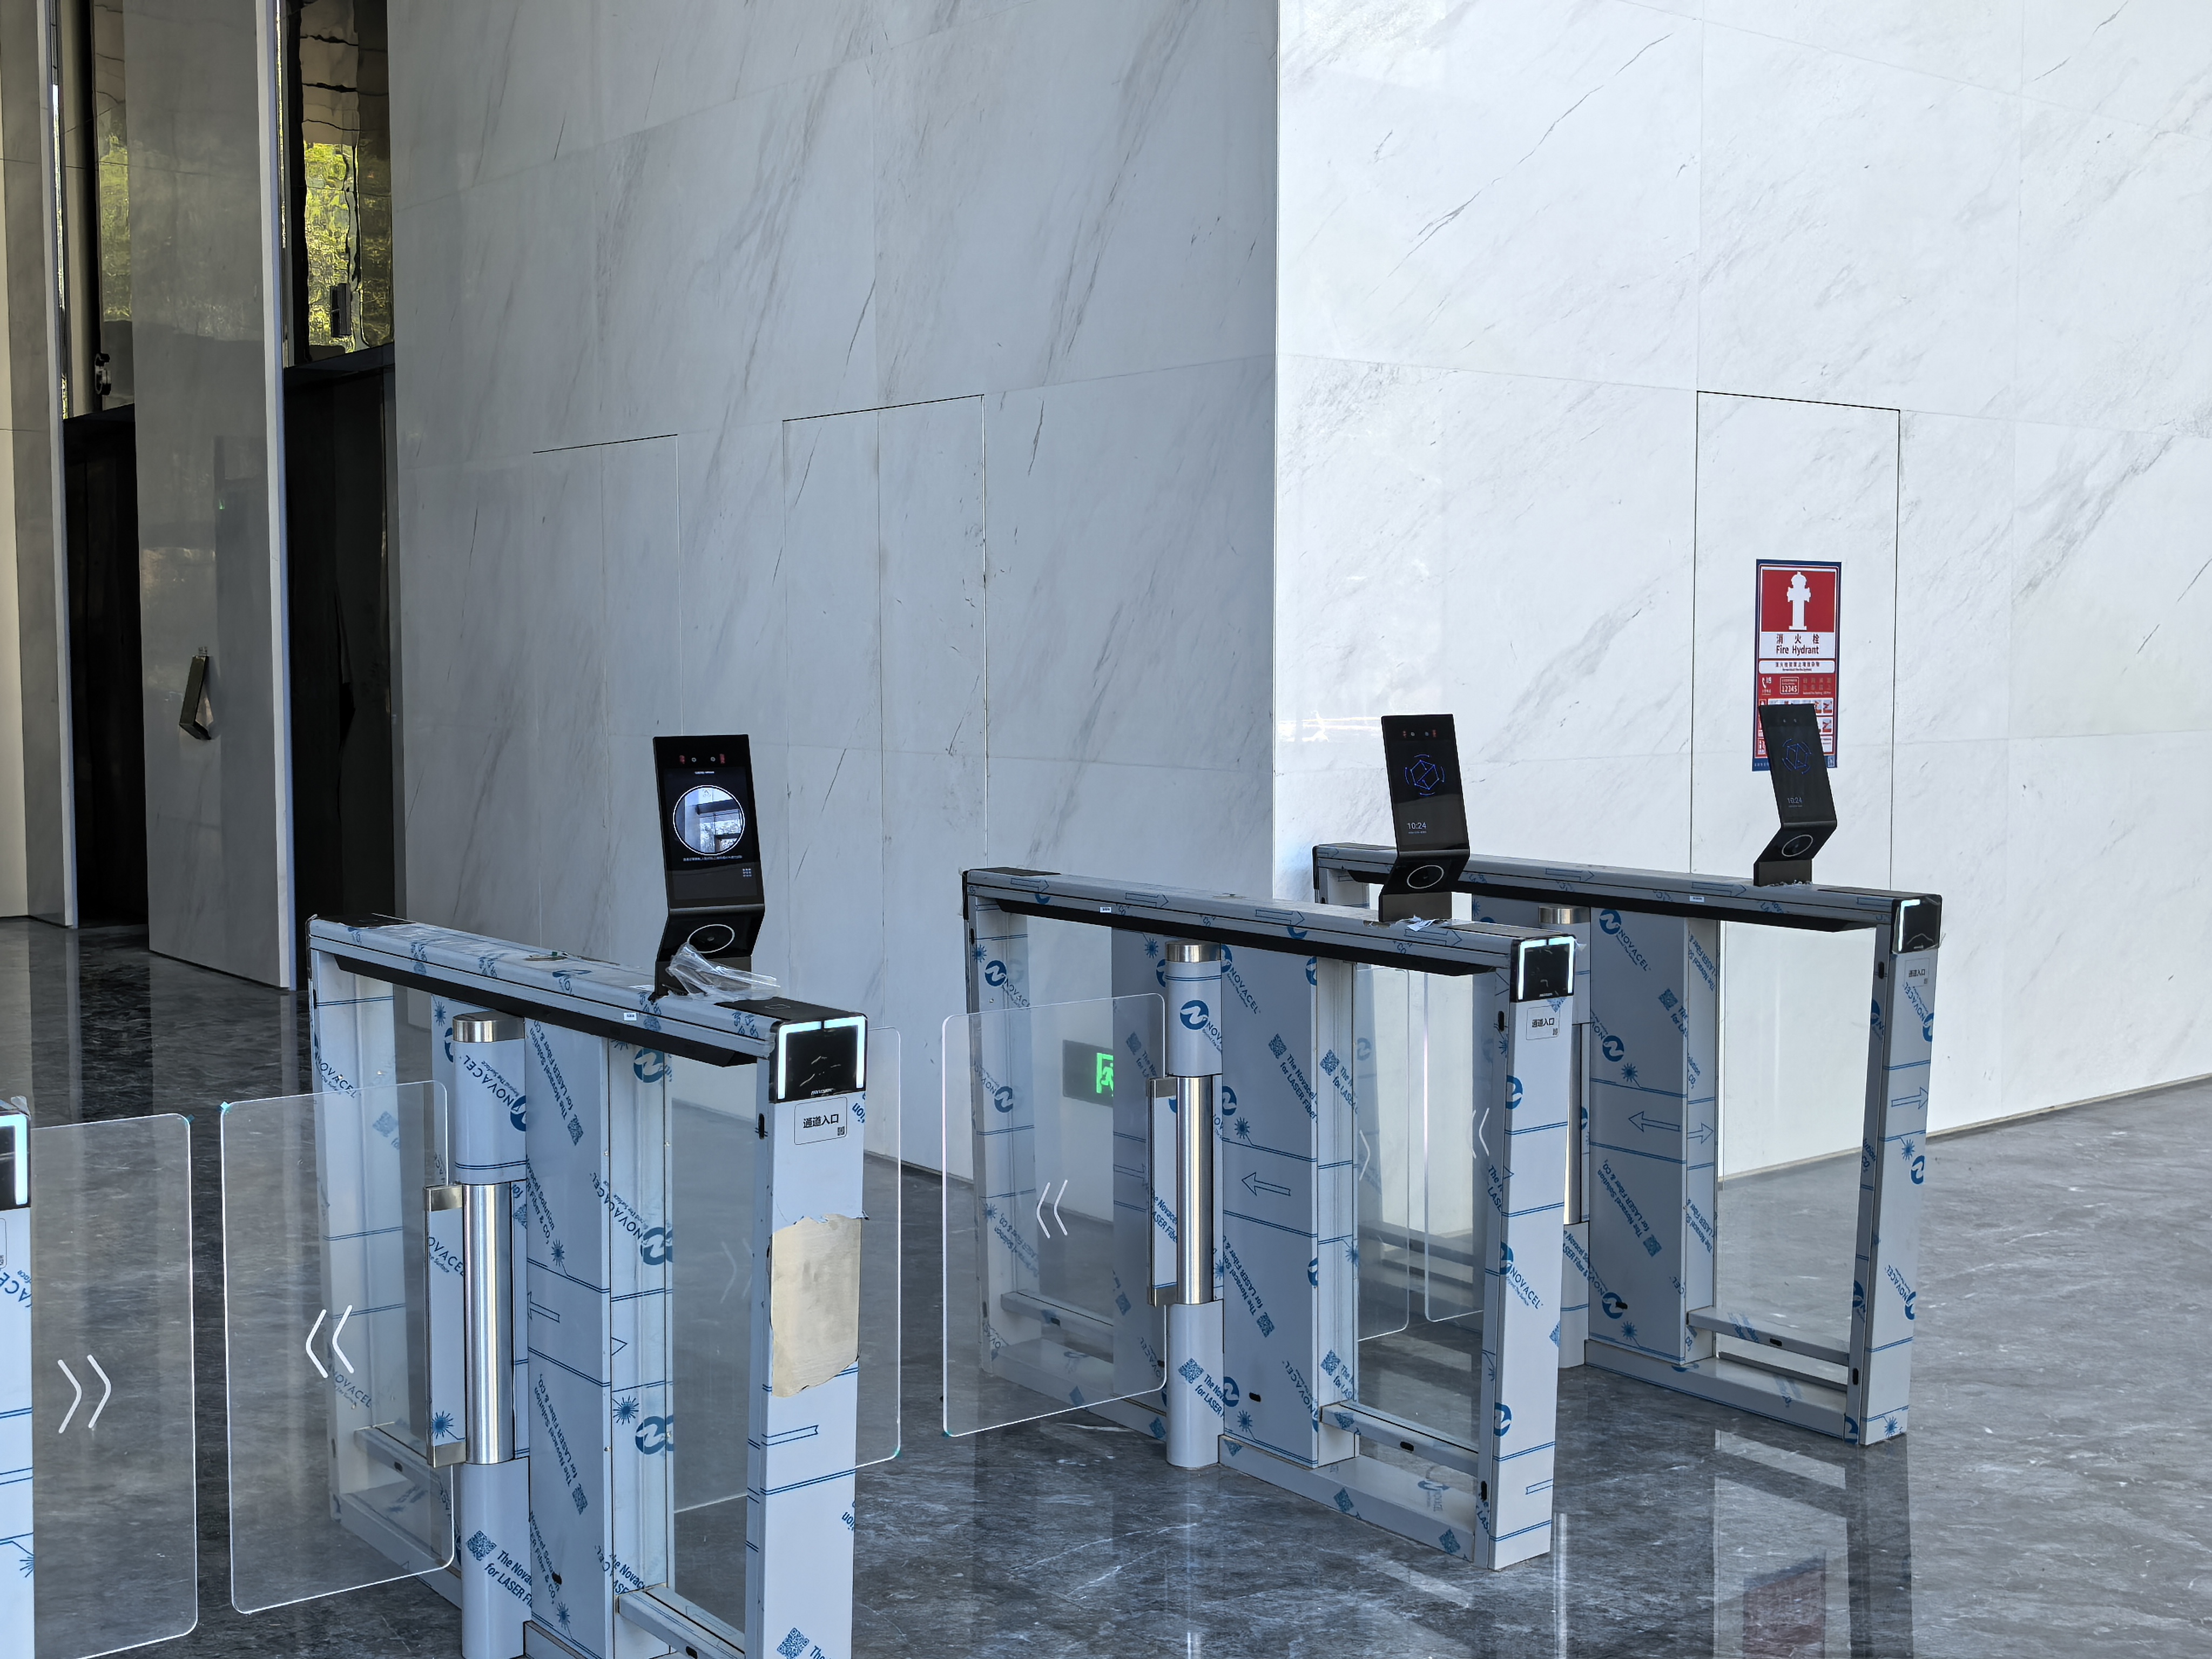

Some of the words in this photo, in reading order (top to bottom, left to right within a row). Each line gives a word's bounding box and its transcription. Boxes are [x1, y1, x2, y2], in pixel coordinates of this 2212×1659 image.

[1776, 633, 1819, 644] 消火栓
[1776, 645, 1789, 655] Fire
[1792, 645, 1819, 656] Hydrant
[1618, 929, 1648, 972] NOVACEL
[1230, 967, 1259, 1014] NOVACEL
[463, 1055, 514, 1107] NOVACEL
[543, 1064, 561, 1102] Novacel
[552, 1063, 568, 1096] LASER
[1280, 1062, 1289, 1075] for
[1287, 1074, 1305, 1101] LASER
[1287, 1054, 1297, 1071] The
[1295, 1069, 1317, 1100] Novacel
[1340, 1065, 1350, 1081] The
[559, 1100, 568, 1121] The
[565, 1095, 574, 1111] for
[803, 1114, 839, 1128] 通道入口
[1488, 1164, 1499, 1183] The
[1597, 1169, 1617, 1198] Solution
[1614, 1197, 1634, 1225] Novacel
[1625, 1197, 1642, 1221] LASER
[1633, 1224, 1643, 1238] The
[1641, 1220, 1650, 1232] for
[1230, 1250, 1242, 1270] Fiber
[1229, 1268, 1249, 1300] Novacel
[1240, 1269, 1257, 1296] LASER
[1510, 1267, 1540, 1310] NOVACEL
[1247, 1298, 1257, 1316] The
[1255, 1297, 1264, 1309] for
[1204, 1374, 1215, 1389] The
[1340, 1365, 1350, 1380] The
[534, 1386, 550, 1428] Solution
[1204, 1393, 1222, 1415] LASER
[548, 1427, 565, 1467] Novacel
[557, 1428, 572, 1463] LASER
[563, 1465, 572, 1487] The
[497, 1549, 513, 1568] The
[484, 1562, 500, 1577] for
[497, 1573, 525, 1599] LASER
